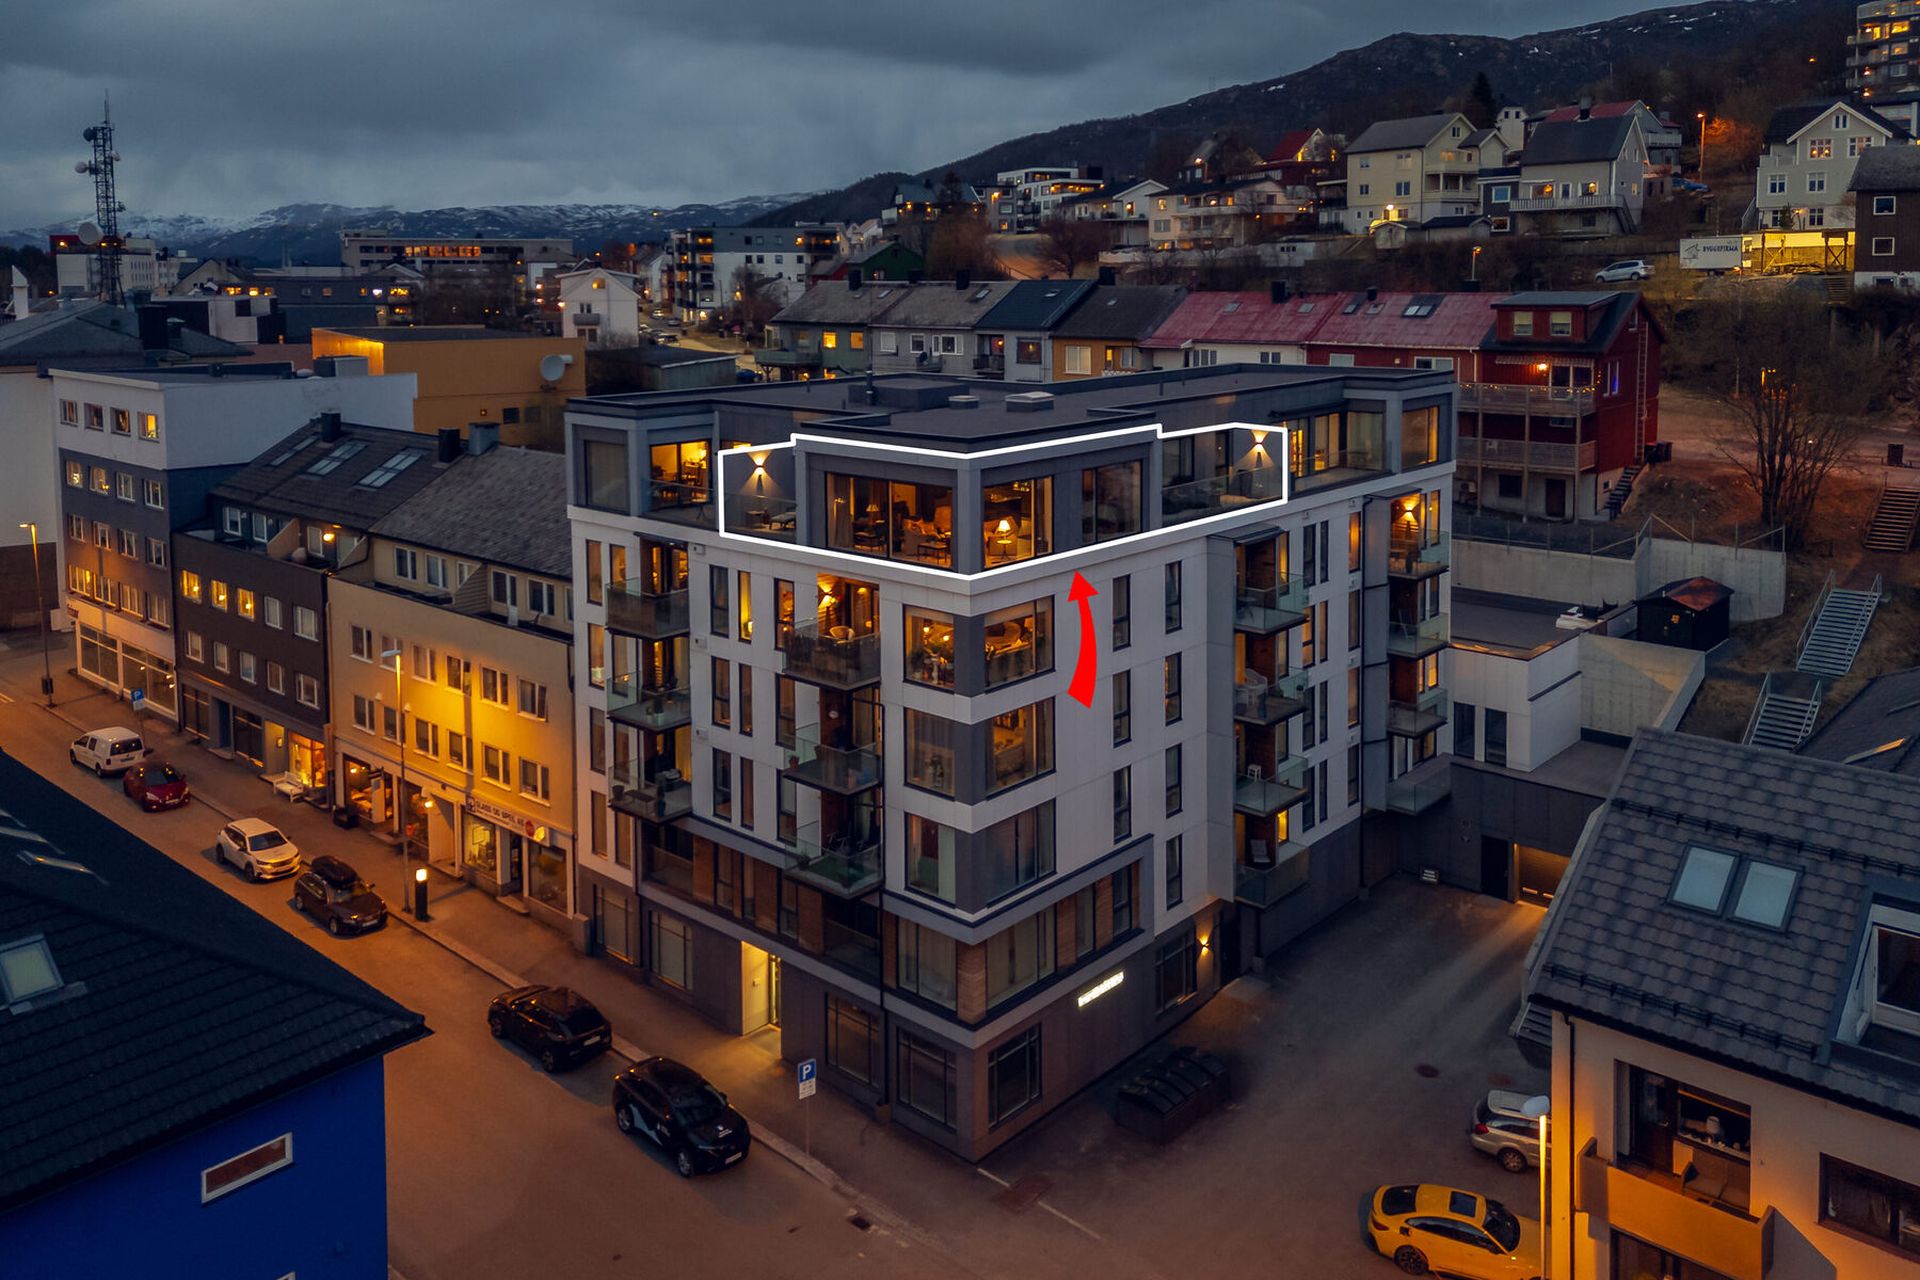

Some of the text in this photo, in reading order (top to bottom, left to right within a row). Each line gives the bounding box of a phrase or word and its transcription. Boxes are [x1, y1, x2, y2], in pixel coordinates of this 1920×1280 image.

[1702, 245, 1739, 253] BYGGEFIRMA
[134, 690, 141, 700] P
[802, 1063, 812, 1080] P
